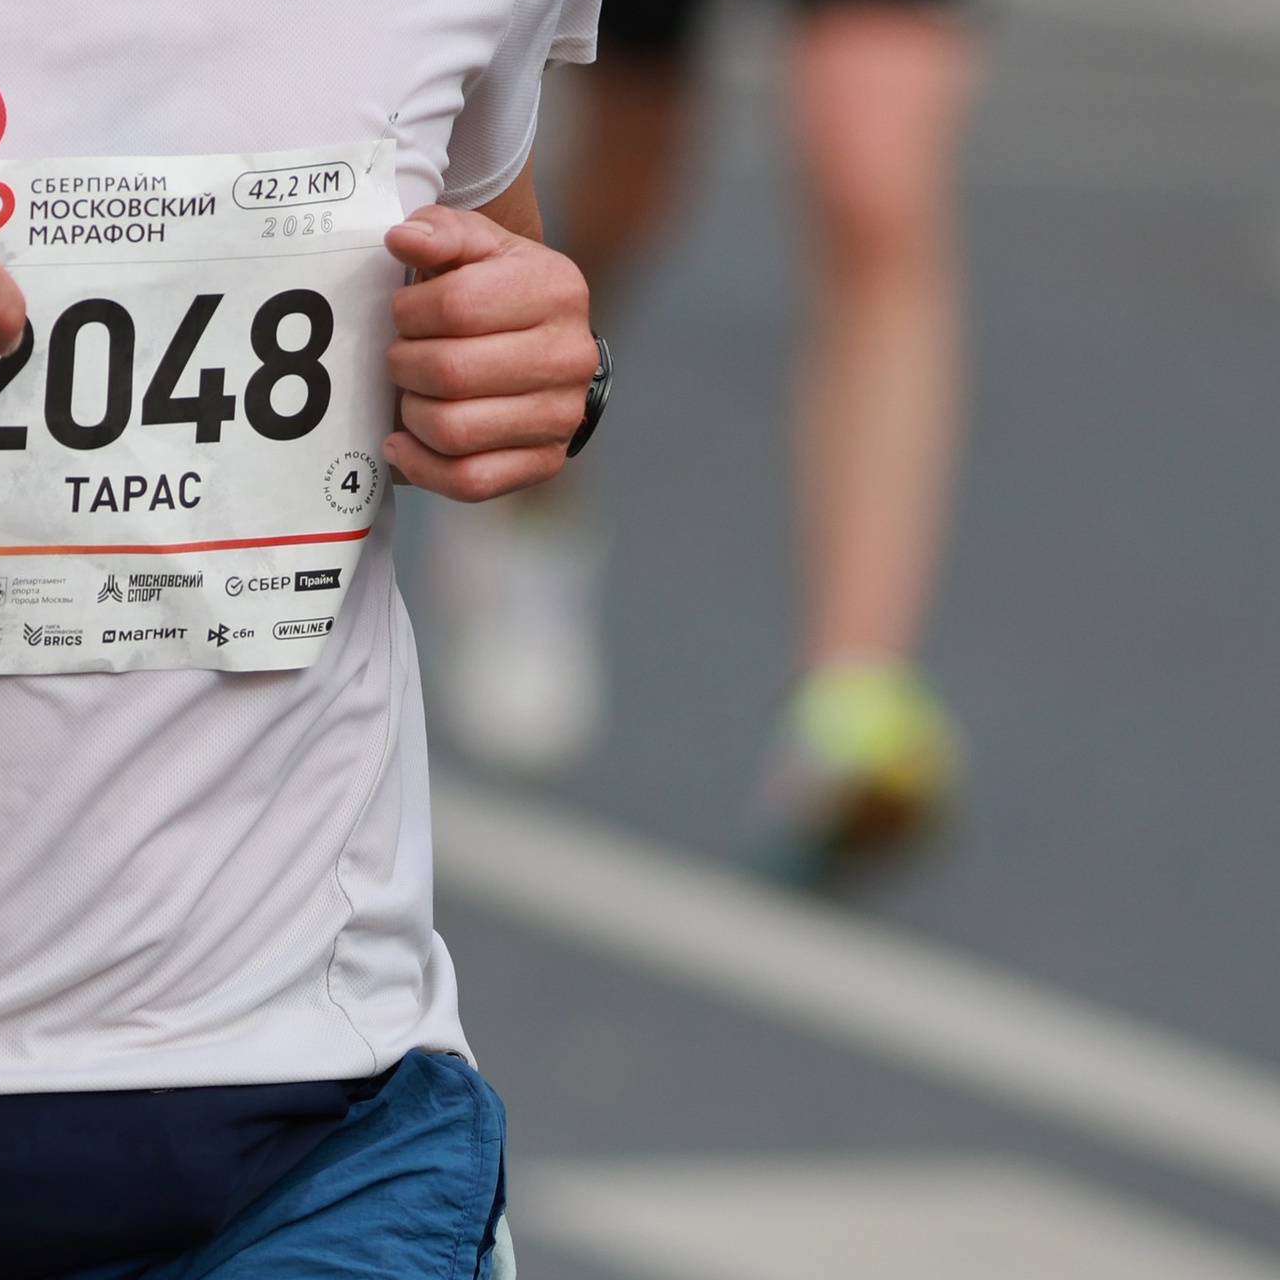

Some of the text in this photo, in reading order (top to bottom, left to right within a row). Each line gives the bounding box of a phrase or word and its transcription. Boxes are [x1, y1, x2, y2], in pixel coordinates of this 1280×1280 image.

[30, 172, 168, 194] СБЕРПРАЙМ
[248, 170, 341, 201] 42,2 КМ
[29, 192, 215, 221] МОСКОВСКИЙ
[29, 222, 166, 246] МАРАФОН
[261, 211, 334, 239] 2026
[323, 451, 379, 514] БЕГУ МОСКОВСКИЙ МАРАФОН
[340, 470, 361, 494] 4
[65, 472, 201, 514] ТАРАС
[12, 577, 66, 586] Департамент
[127, 570, 204, 588] МОСКОВСКИЙ
[247, 574, 334, 592] СБЕР Прайм
[11, 587, 40, 595] спорта
[127, 588, 162, 603] СПОРТ
[11, 596, 73, 605] города Москвы
[118, 627, 188, 643] магнит
[232, 627, 255, 640] сбп
[277, 621, 325, 637] WINLINE
[44, 635, 82, 646] BRICS
